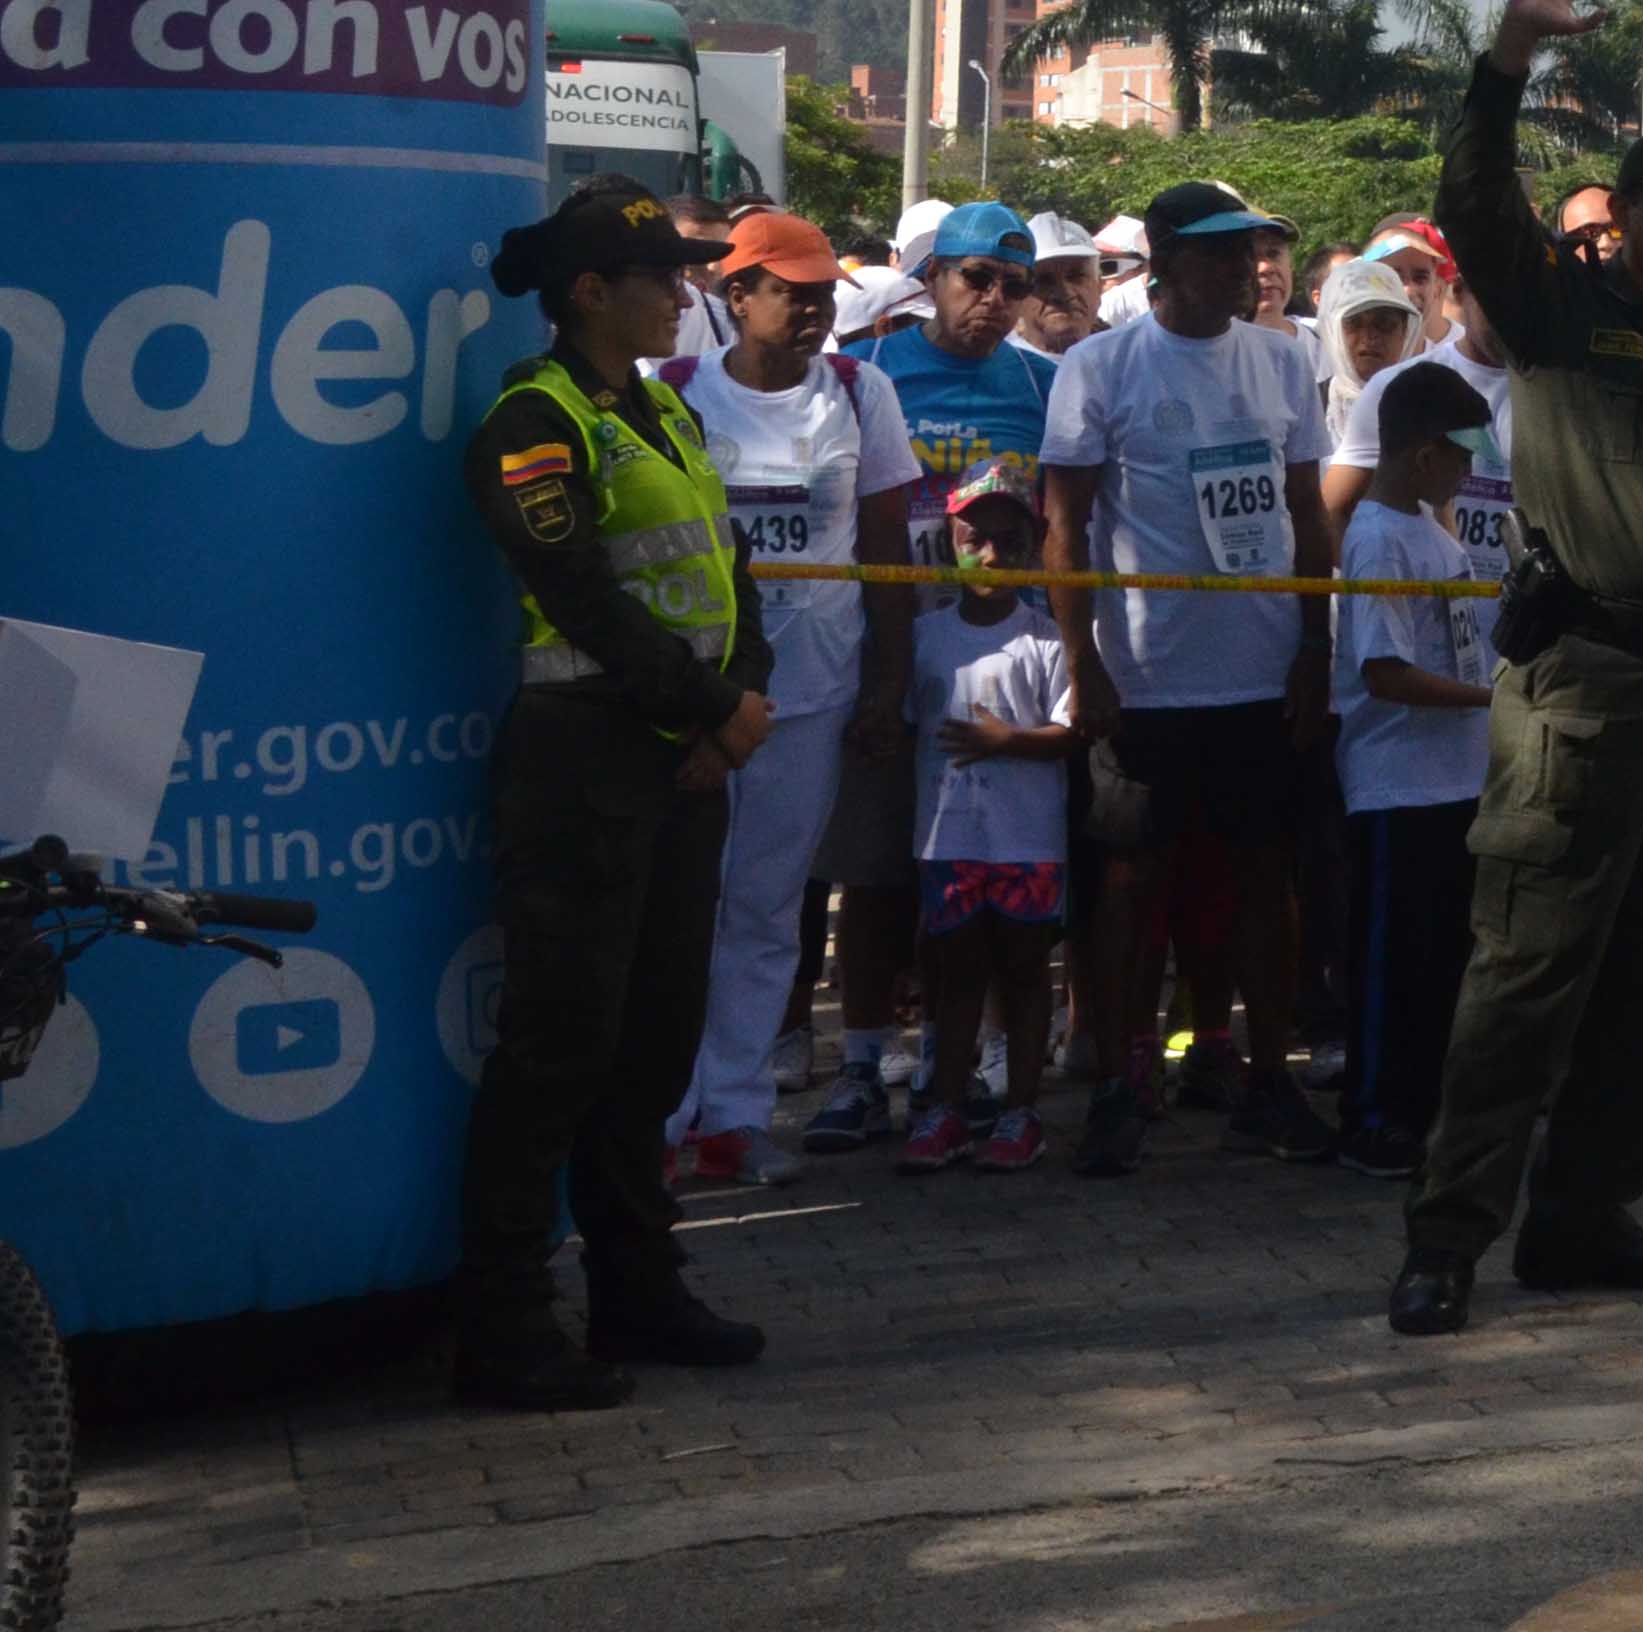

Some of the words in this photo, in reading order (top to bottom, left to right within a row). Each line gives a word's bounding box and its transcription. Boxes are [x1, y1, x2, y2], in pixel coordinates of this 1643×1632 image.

[404, 4, 527, 94] vos
[545, 82, 690, 110] NACIONAL
[547, 109, 690, 131] DOLESCENCIA
[1201, 475, 1275, 519] 1269
[730, 514, 809, 553] 439
[100, 812, 494, 894] ellin.gov.
